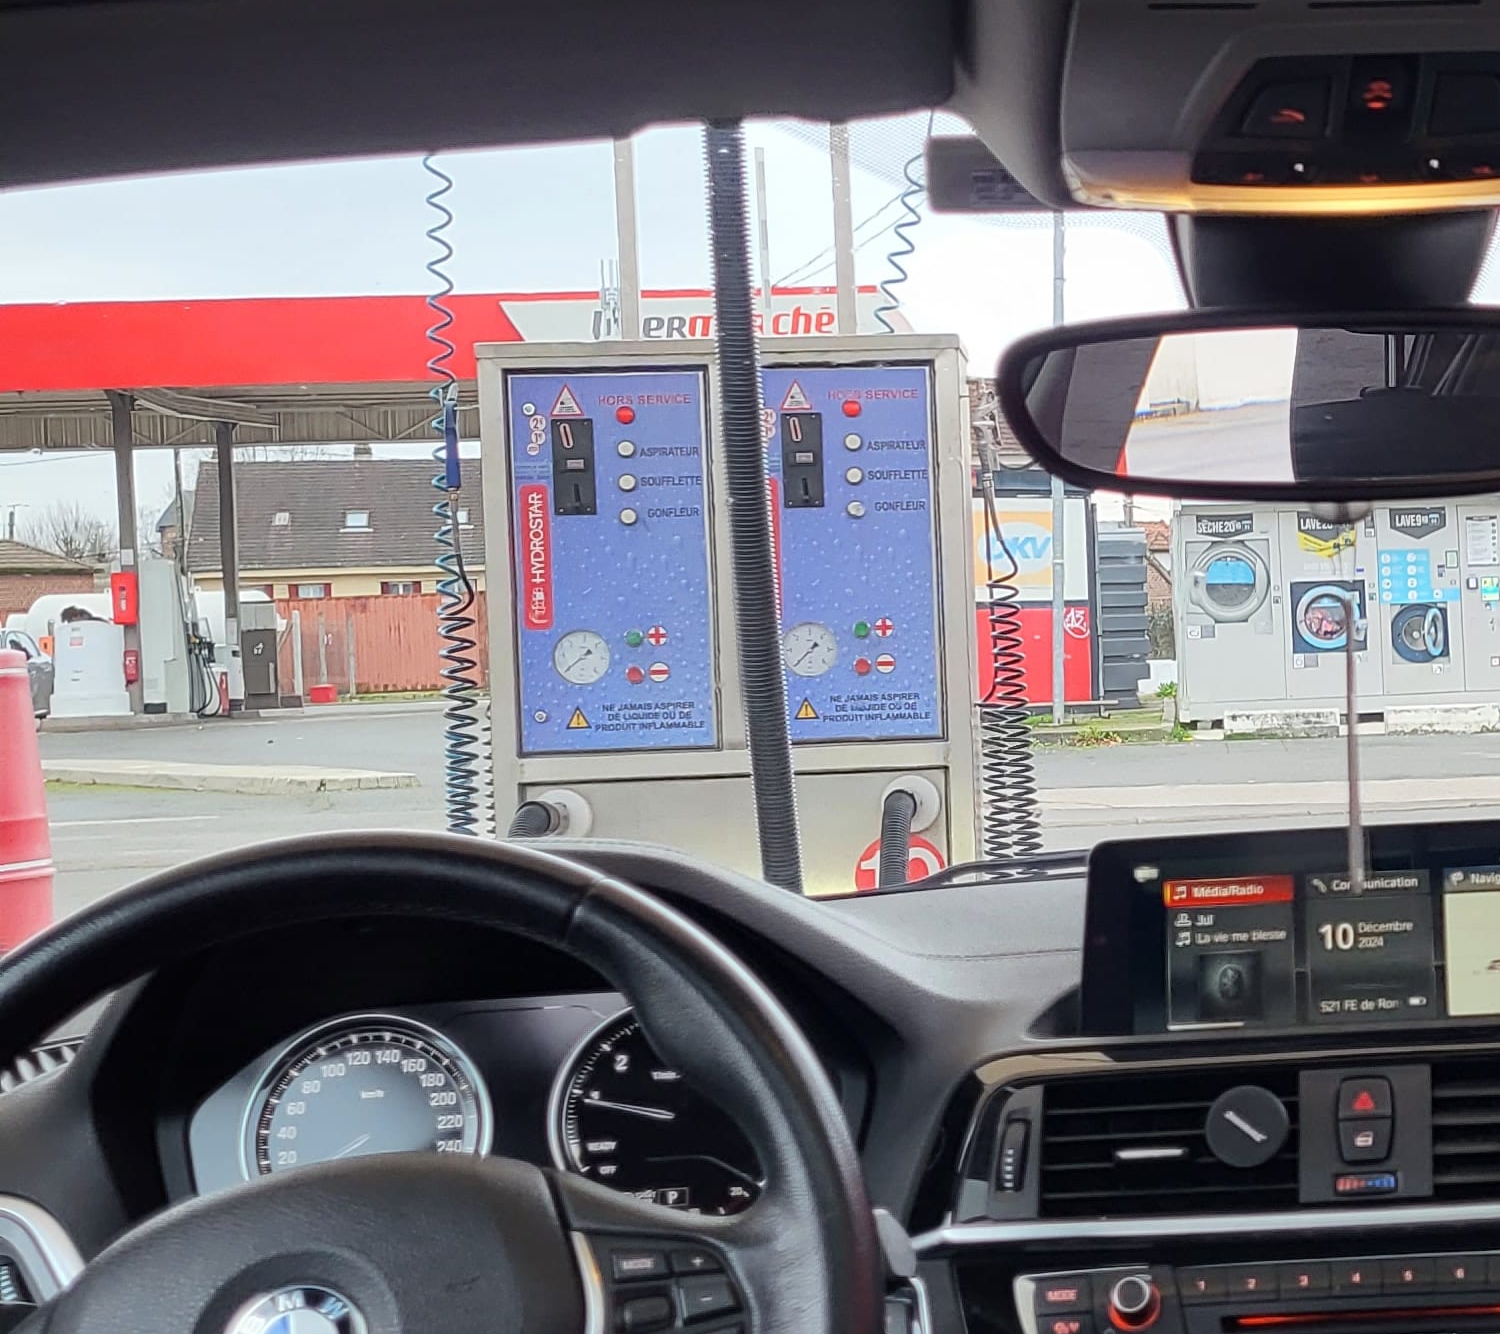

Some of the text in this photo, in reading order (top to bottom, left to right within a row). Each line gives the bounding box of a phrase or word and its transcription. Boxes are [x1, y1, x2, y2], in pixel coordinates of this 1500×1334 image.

[598, 393, 692, 406] HORS SERVICE
[865, 389, 920, 400] SERVICE
[866, 440, 926, 451] ASPIRATEUR
[640, 447, 699, 458] ASPIRATEUR
[641, 475, 702, 487] SOUFFLETTE
[868, 469, 928, 480] SOUFFLETTE
[648, 506, 699, 518] GONFLEUR
[875, 501, 925, 512] GONFLEUR
[528, 492, 546, 583] HYDROSTAR
[830, 692, 920, 703] NE JAMAIS ASPIRER
[602, 701, 695, 712] NE JAMAIS ASPIRER
[835, 704, 848, 713] DE
[904, 702, 917, 711] DE
[608, 711, 692, 722] DE LIQUIDE OU DE
[823, 712, 930, 723] PRODUIT INFLAMMABLE
[595, 721, 705, 732] PRODUIT INFLAMMABLE
[1192, 884, 1264, 899] Média/Radio
[1213, 932, 1229, 943] vie
[1232, 932, 1249, 942] me
[1252, 930, 1287, 941] blesse
[1318, 922, 1355, 950] 10
[1358, 936, 1384, 948] 2024
[1344, 999, 1358, 1011] FE
[1361, 998, 1376, 1011] de
[346, 1051, 371, 1065] 120
[375, 1049, 400, 1064] 140
[614, 1054, 628, 1071] 2
[321, 1063, 345, 1077] 100
[401, 1058, 426, 1073] 160
[420, 1073, 445, 1087] 180
[302, 1080, 320, 1094] 80
[430, 1091, 456, 1106] 200
[287, 1101, 305, 1115] 60
[437, 1115, 463, 1129] 220
[277, 1126, 296, 1139] 40
[437, 1140, 462, 1153] 240
[278, 1151, 297, 1165] 20
[598, 1165, 617, 1175] OFF
[667, 1190, 678, 1204] P
[1046, 1288, 1078, 1302] MODE
